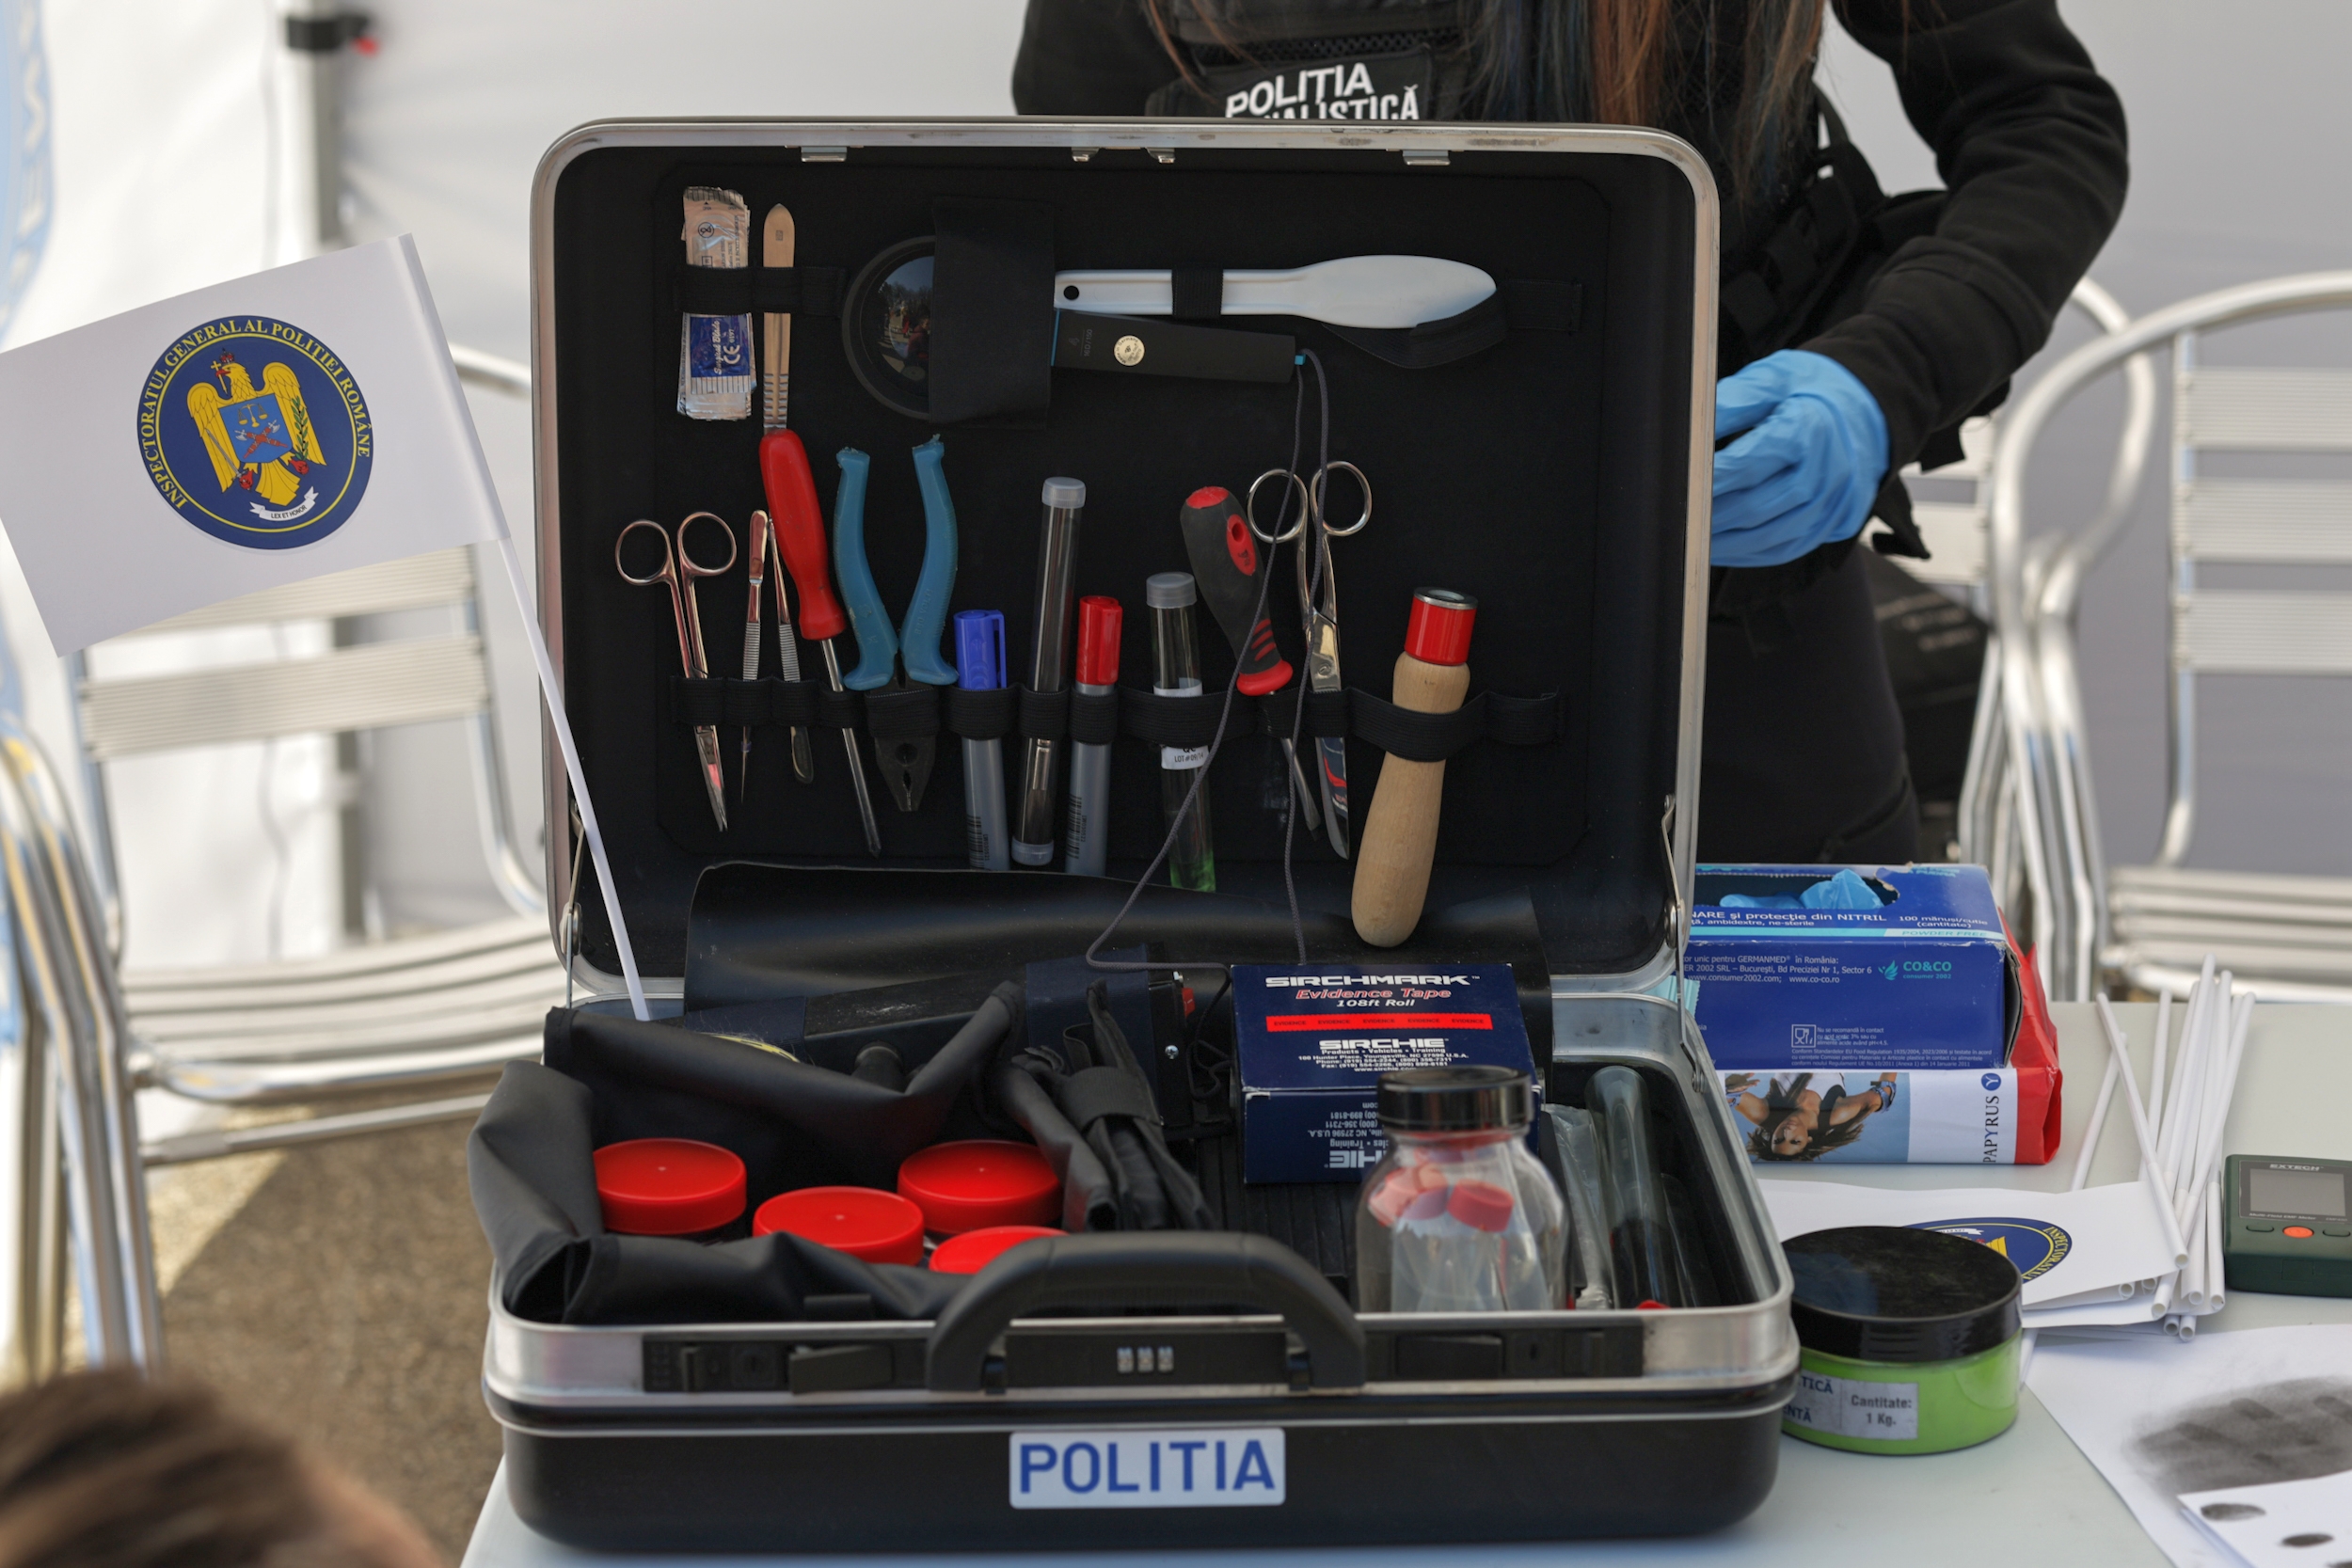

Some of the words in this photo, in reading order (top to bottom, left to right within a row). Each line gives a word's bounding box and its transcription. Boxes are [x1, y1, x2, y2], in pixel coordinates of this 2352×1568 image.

[141, 369, 188, 510] INSPECTORATUL
[165, 320, 243, 367] GENERAL
[245, 319, 268, 333] AL
[272, 322, 346, 378] POLIȚIEI
[339, 377, 373, 458] ROMÂNE
[290, 504, 307, 517] HONOR
[1903, 961, 1952, 972] CO&CO
[1295, 989, 1393, 999] Evidence
[1401, 988, 1452, 1000] Tape
[1336, 999, 1379, 1007] 108ft
[1364, 1110, 1378, 1119] 00)
[1359, 1119, 1378, 1128] (800)
[1982, 1095, 1999, 1163] PAPYRUS
[1330, 1138, 1364, 1149] Training
[1799, 1376, 1834, 1394] TICĂ
[1851, 1395, 1913, 1409] Cantitate:
[1867, 1414, 1872, 1423] 1
[1878, 1414, 1897, 1428] Kg.
[1020, 1439, 1276, 1494] POLITIA
